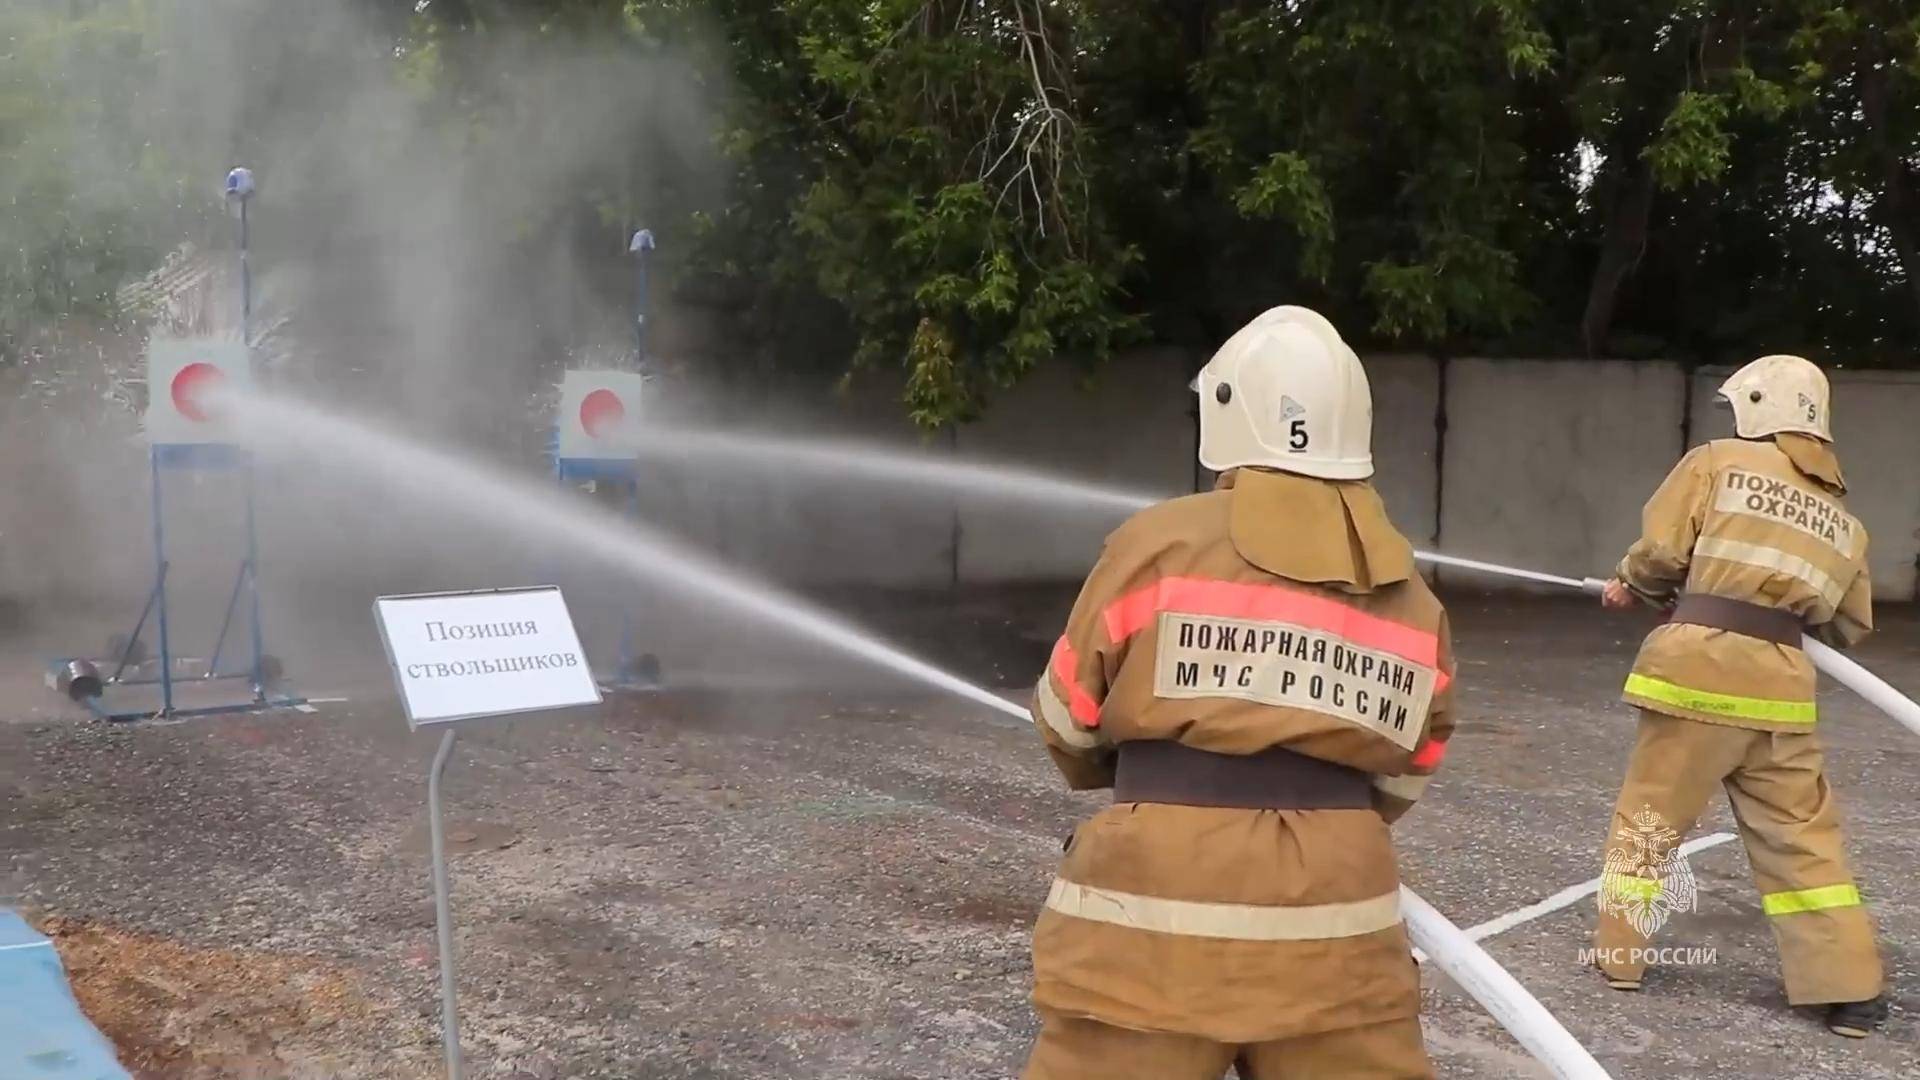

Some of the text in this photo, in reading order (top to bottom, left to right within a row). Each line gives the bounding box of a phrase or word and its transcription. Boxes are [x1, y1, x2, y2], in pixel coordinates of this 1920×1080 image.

[1807, 404, 1816, 421] 5
[1289, 420, 1308, 449] 5
[1727, 472, 1850, 536] ПОЖАРНАЯ
[1747, 494, 1836, 543] ОХРАНА
[425, 620, 538, 641] Позиция
[407, 652, 577, 678] ствольщиков
[1179, 623, 1415, 696] ПОЖАРНАЯ ОХРАНА
[1176, 661, 1407, 732] МЧС РОССИИ
